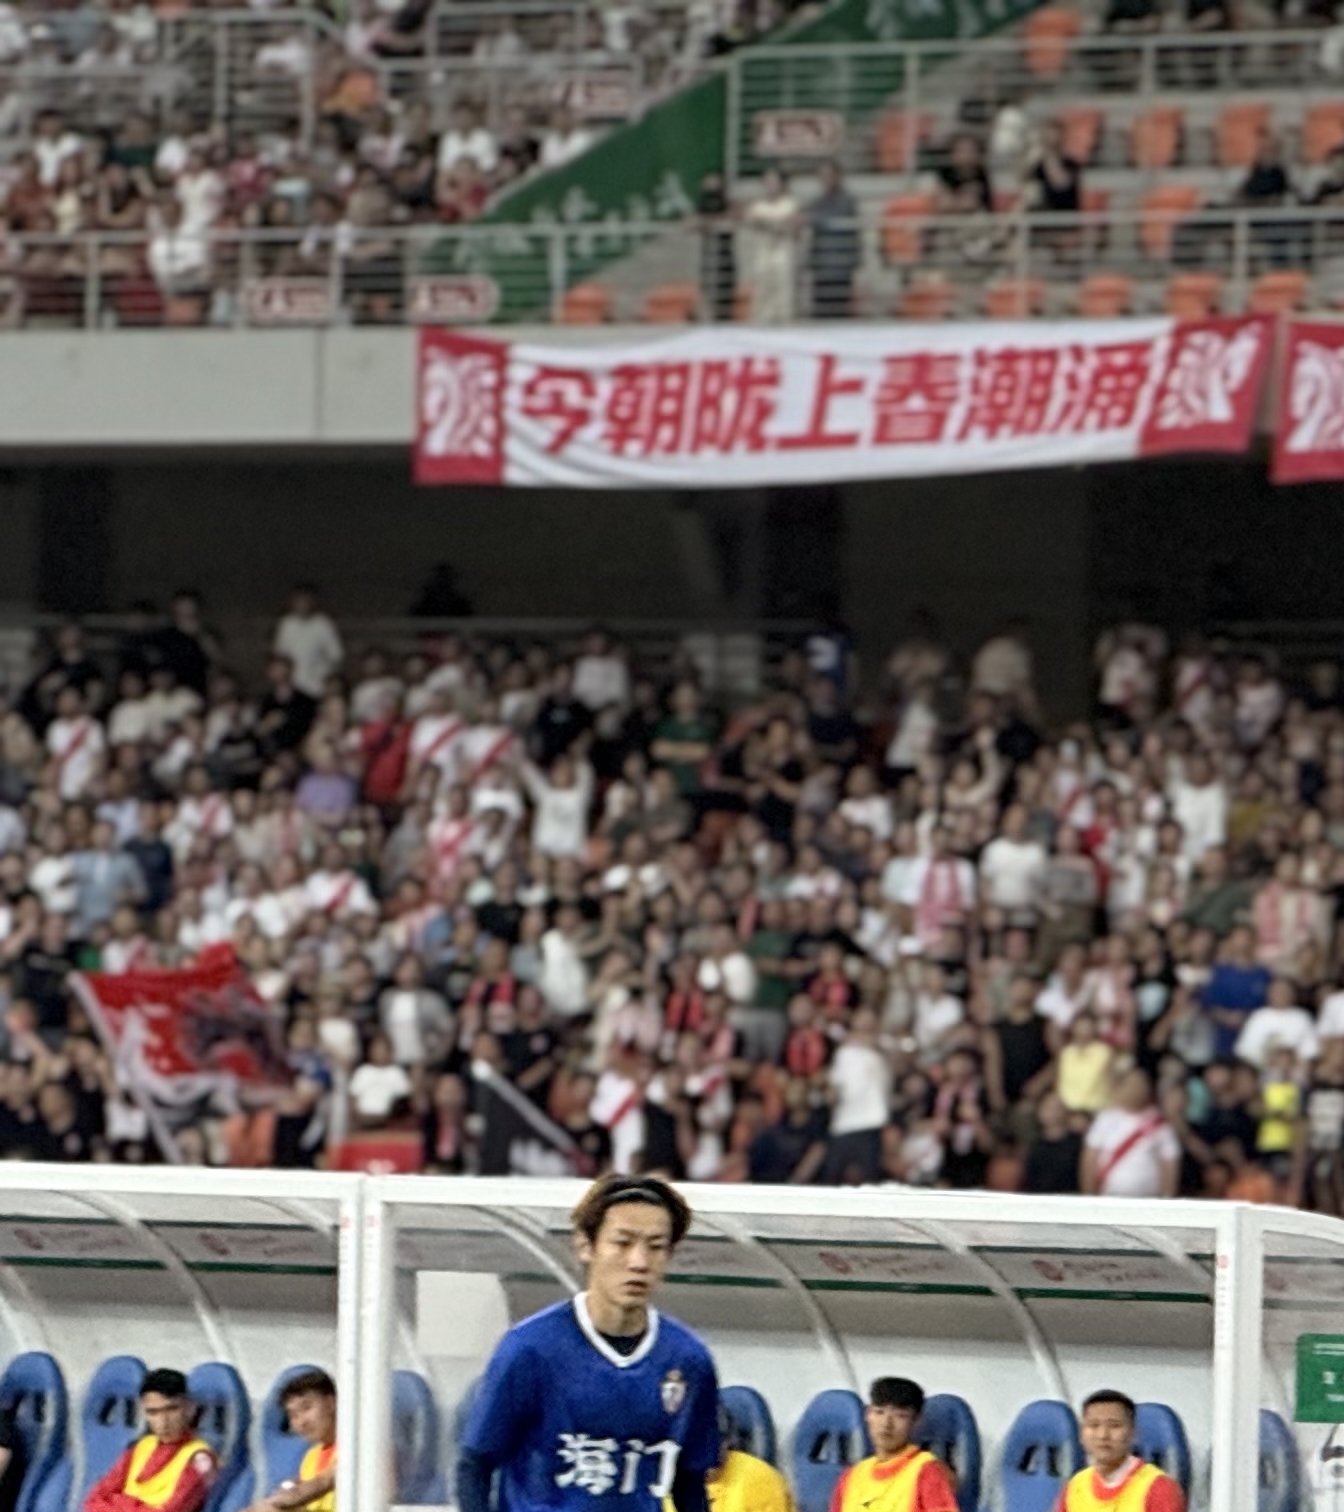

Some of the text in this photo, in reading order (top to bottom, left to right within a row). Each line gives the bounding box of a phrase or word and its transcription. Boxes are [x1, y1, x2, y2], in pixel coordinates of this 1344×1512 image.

[519, 341, 1156, 455] 今朝陇上春潮涌
[557, 1433, 682, 1498] 海门
